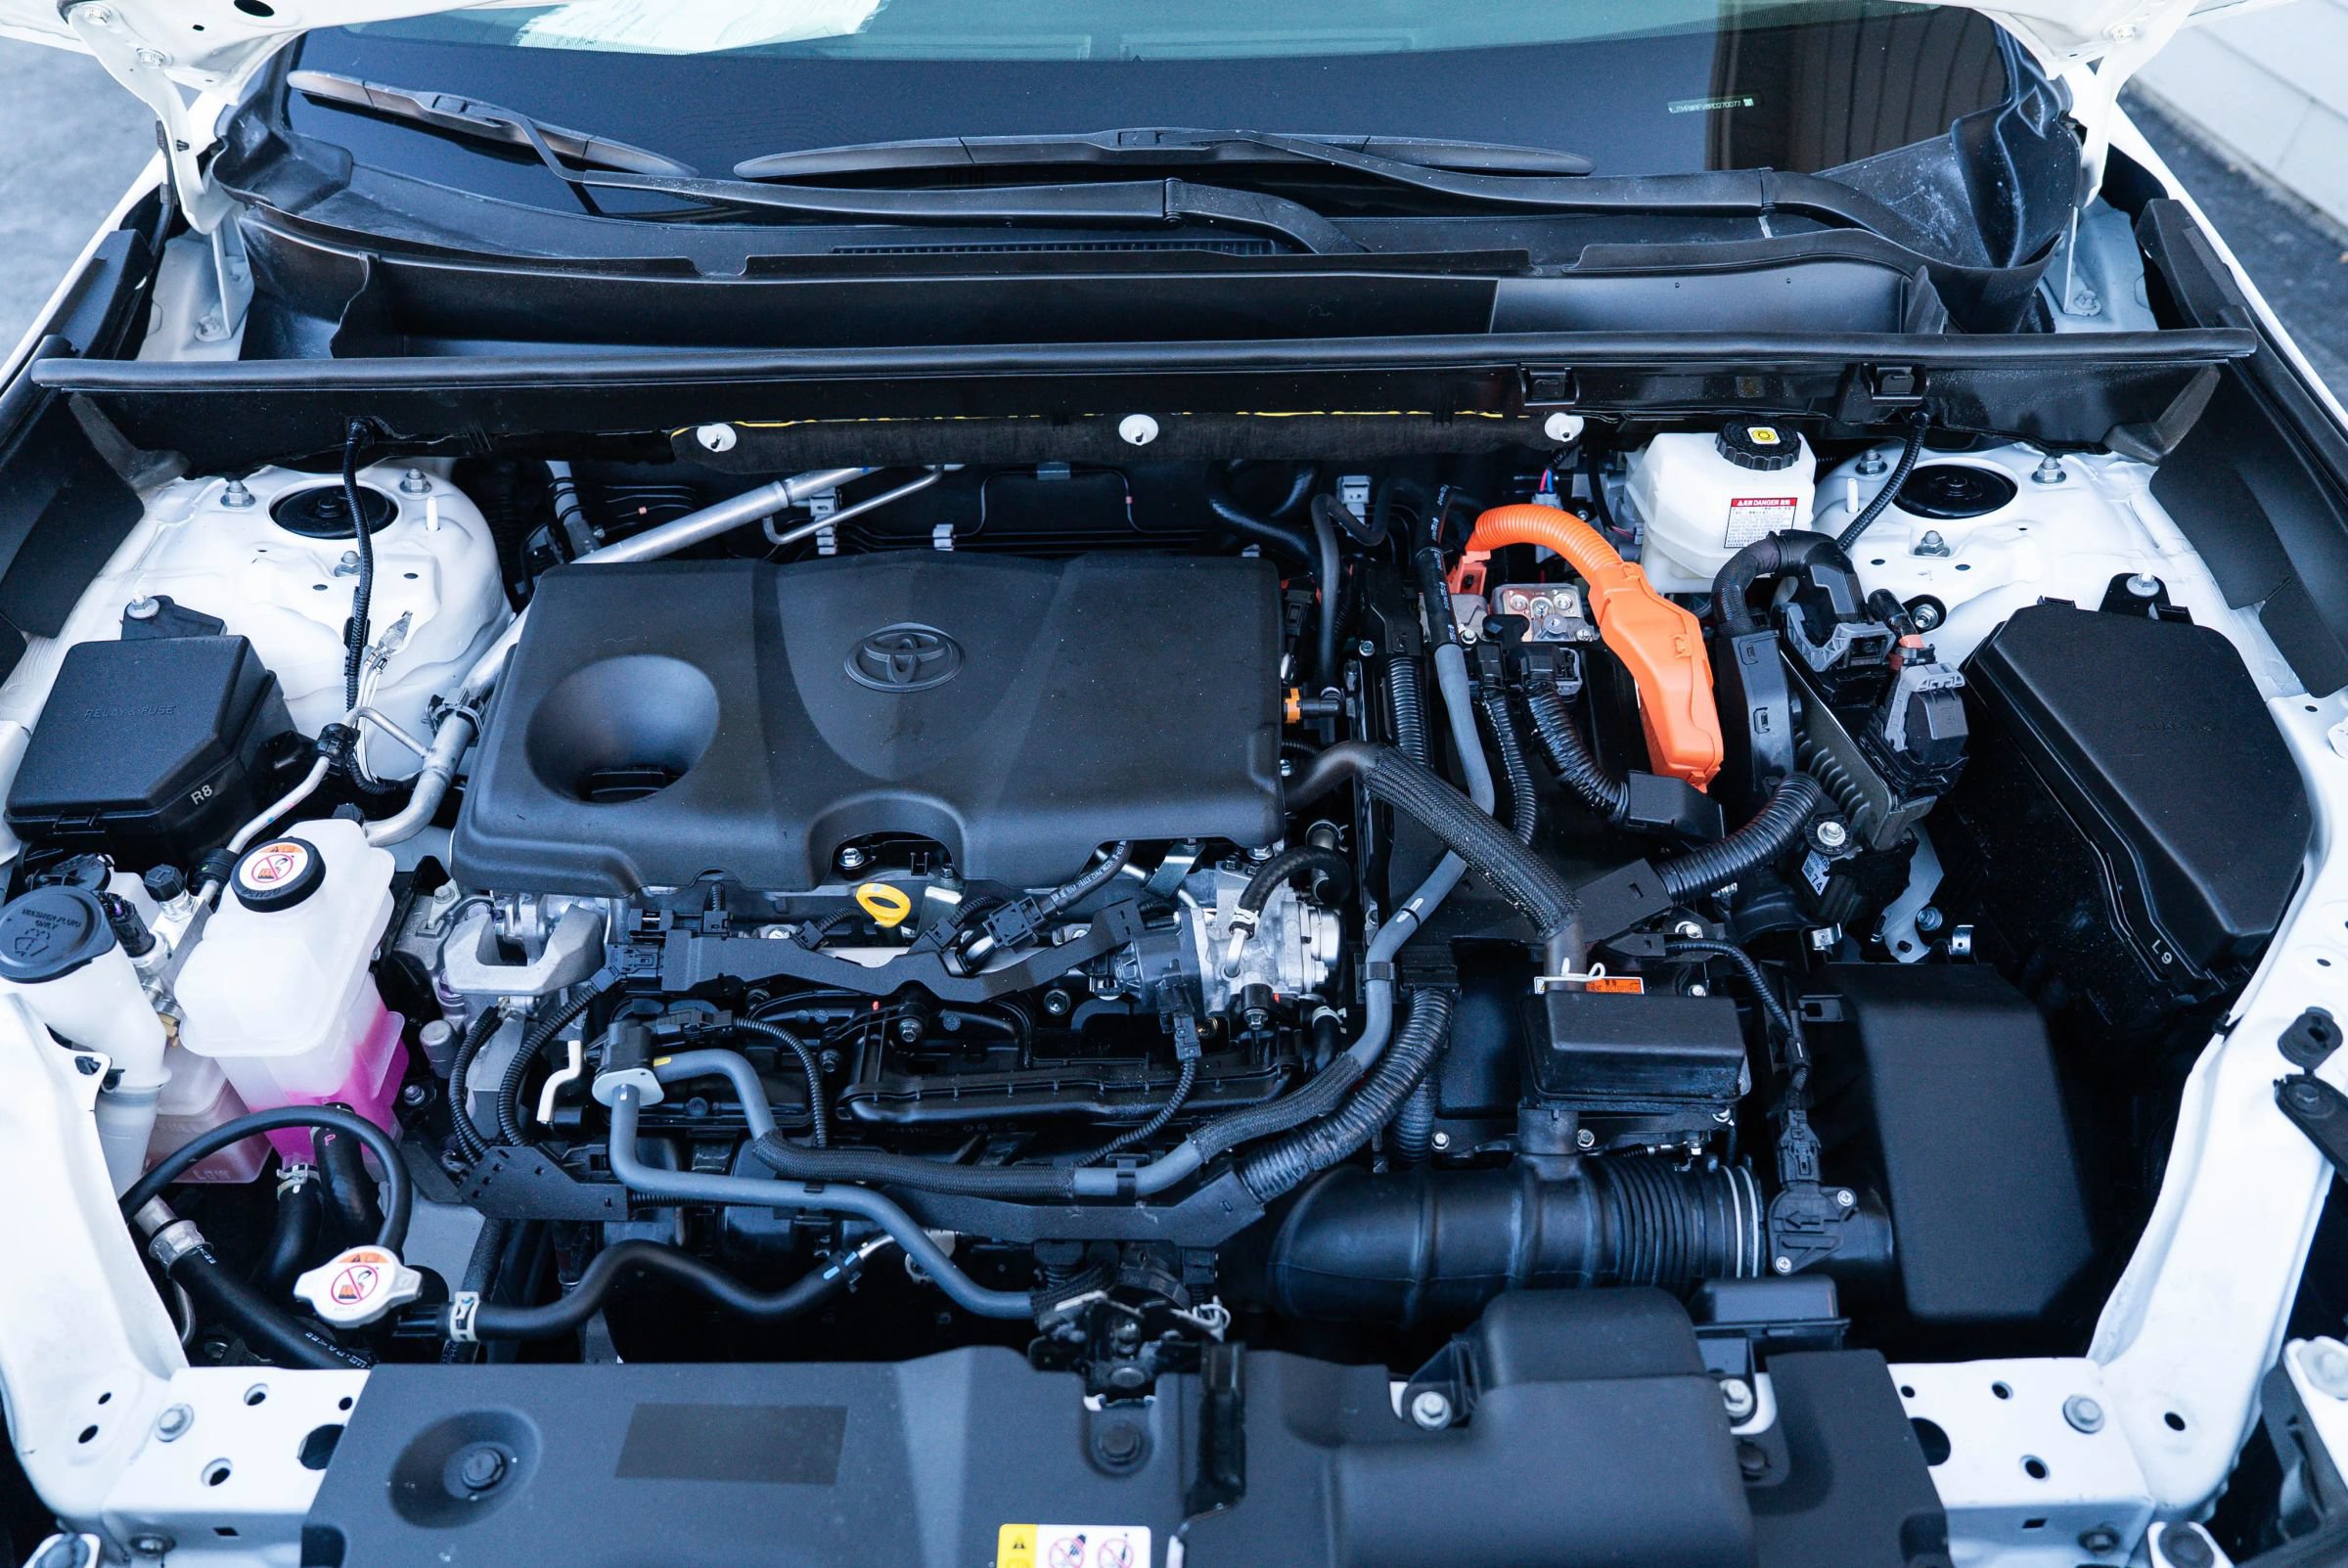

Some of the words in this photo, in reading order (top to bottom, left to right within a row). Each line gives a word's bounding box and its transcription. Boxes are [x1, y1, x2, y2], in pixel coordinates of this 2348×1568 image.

[84, 708, 126, 720] RELAY
[142, 705, 177, 716] FUSE
[190, 784, 213, 805] R8
[23, 909, 57, 921] WASHER
[57, 916, 82, 928] FLUID
[35, 920, 59, 930] ONLY
[2152, 939, 2173, 964] L9
[195, 1170, 231, 1181] LOW
